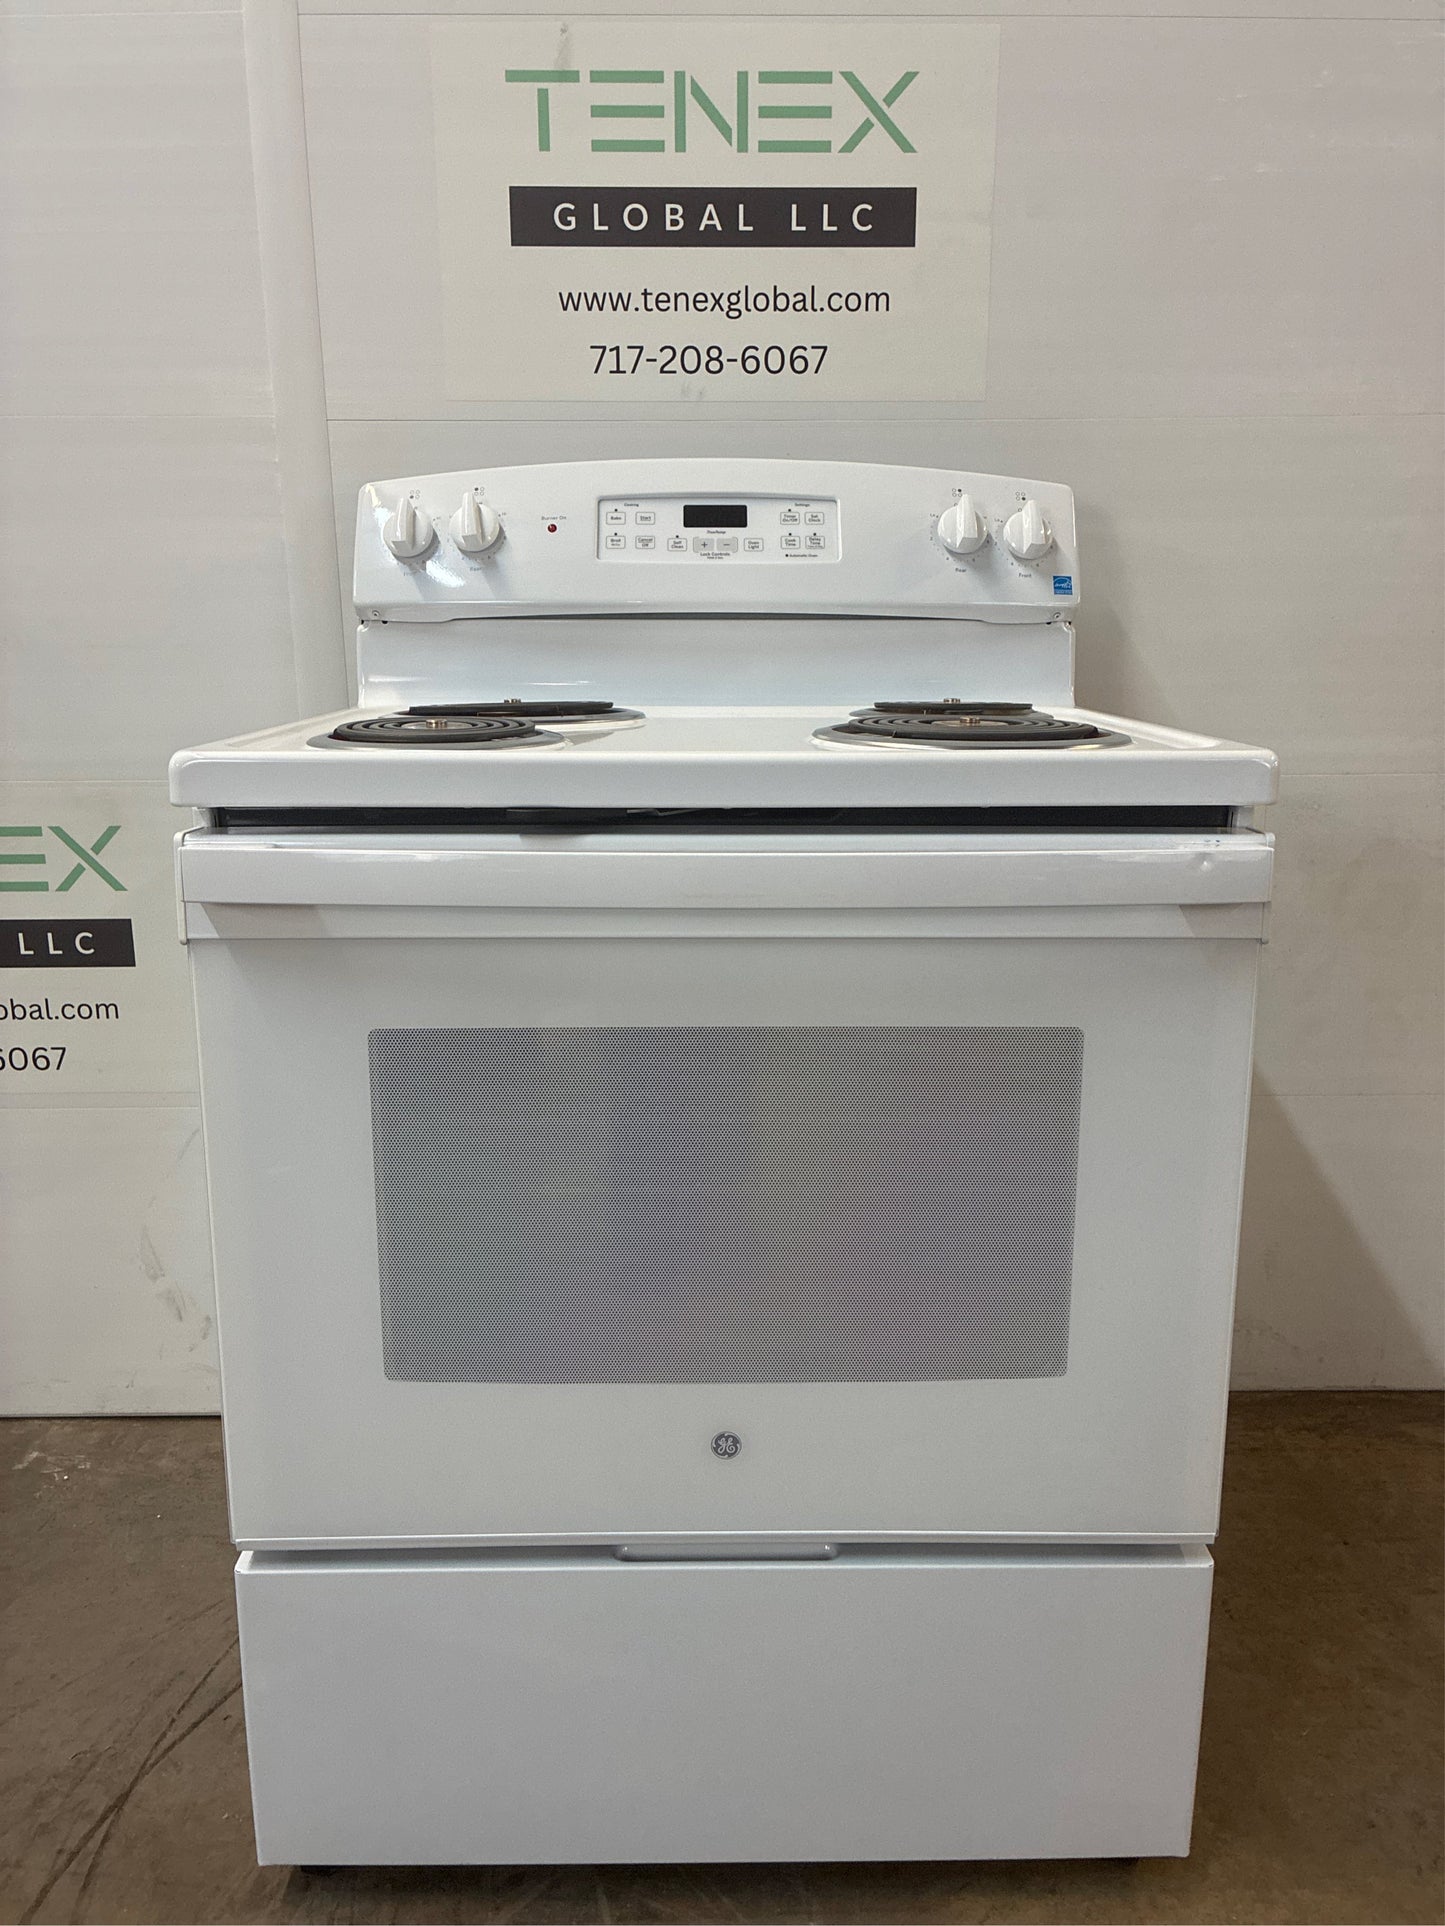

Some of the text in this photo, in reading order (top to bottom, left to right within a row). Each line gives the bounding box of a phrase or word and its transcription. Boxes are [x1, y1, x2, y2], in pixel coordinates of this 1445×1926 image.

[504, 70, 920, 153] TENEX
[552, 203, 875, 231] GLOBAL LLC
[558, 285, 891, 320] www.tenexglobal.com
[589, 344, 829, 375] 717-208-6067
[17, 931, 96, 955] LLC
